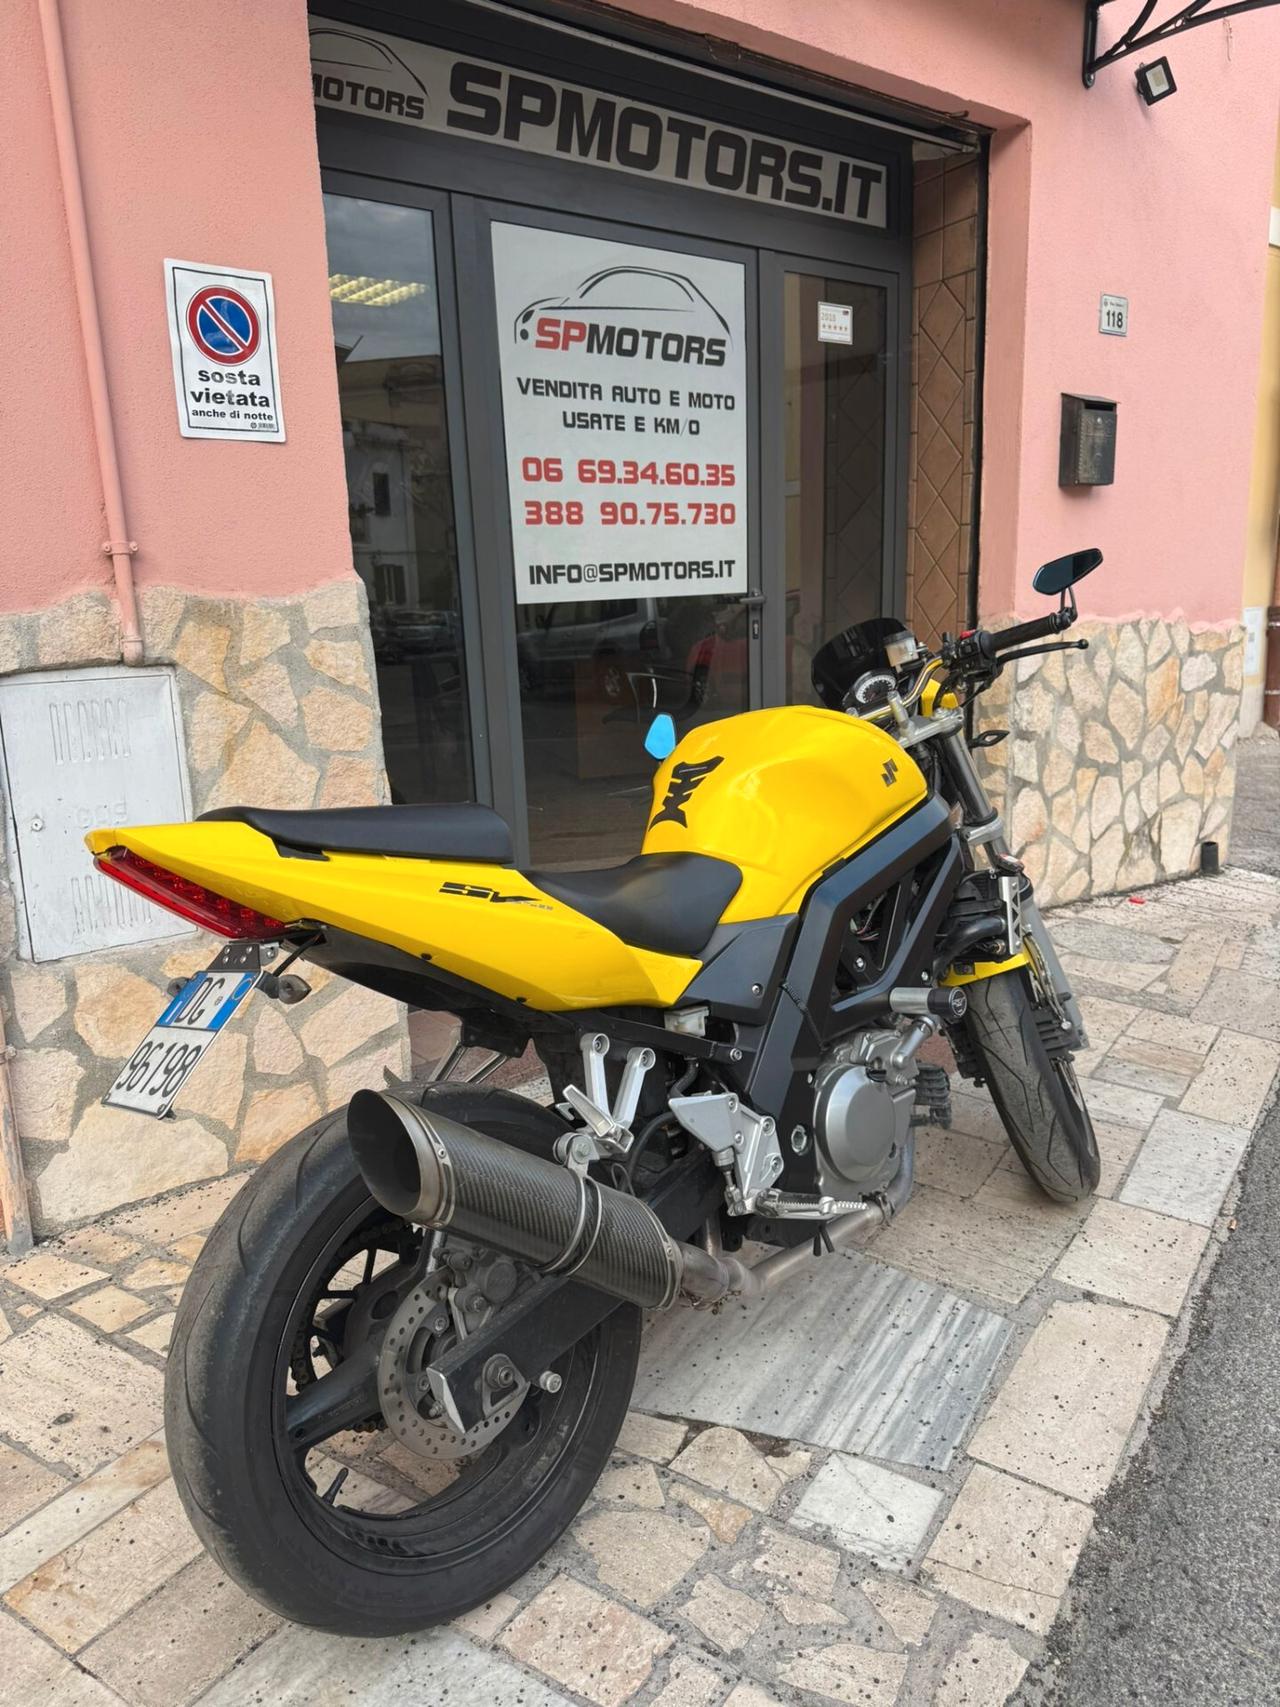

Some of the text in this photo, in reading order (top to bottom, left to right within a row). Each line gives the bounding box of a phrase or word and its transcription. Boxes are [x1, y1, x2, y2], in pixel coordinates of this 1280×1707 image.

[446, 61, 883, 219] SPMOTORS.IT
[1106, 309, 1124, 329] 118
[535, 317, 727, 366] SPMOTORS
[198, 369, 261, 386] sosta
[190, 388, 270, 407] vietata
[516, 376, 735, 411] VENDITA AUTO E MOTO
[192, 408, 273, 421] anche di notte
[562, 410, 625, 431] USATE
[634, 416, 645, 432] E
[522, 456, 736, 487] 06 69.34.60.35
[525, 501, 736, 525] 388 90.75.730
[529, 559, 736, 585] INFO@SPMOTORS.IT
[115, 1040, 203, 1098] 96198
